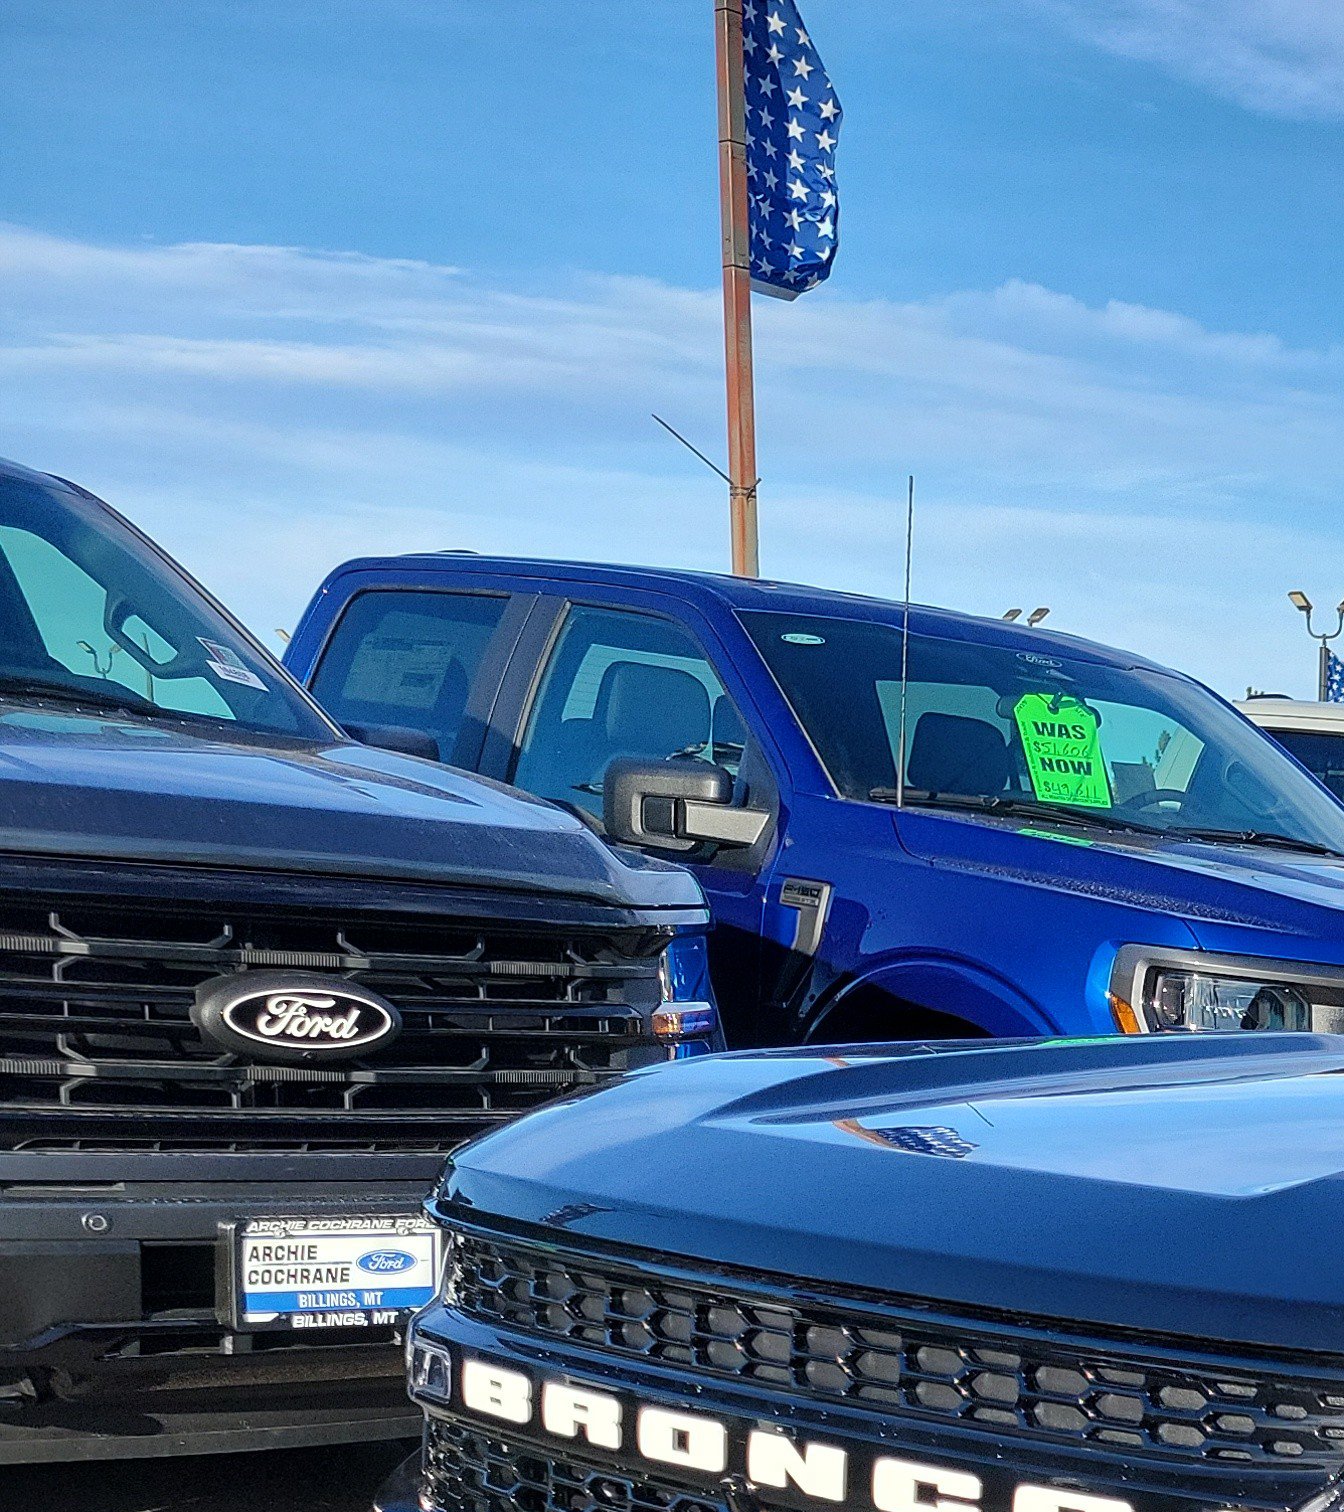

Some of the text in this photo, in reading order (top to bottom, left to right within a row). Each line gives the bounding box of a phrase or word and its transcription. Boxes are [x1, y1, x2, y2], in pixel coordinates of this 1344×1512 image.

[1032, 721, 1086, 740] WAS
[1039, 758, 1093, 776] NOW
[257, 995, 361, 1039] Ford
[247, 1219, 307, 1233] ARCHIE
[308, 1219, 394, 1231] COCHRANE
[248, 1244, 318, 1262] ARCHIE
[369, 1253, 405, 1271] Ford
[248, 1267, 350, 1286] COCHRANE
[298, 1291, 384, 1309] BILLINGS, MT
[292, 1311, 399, 1328] BILLINGS, MT
